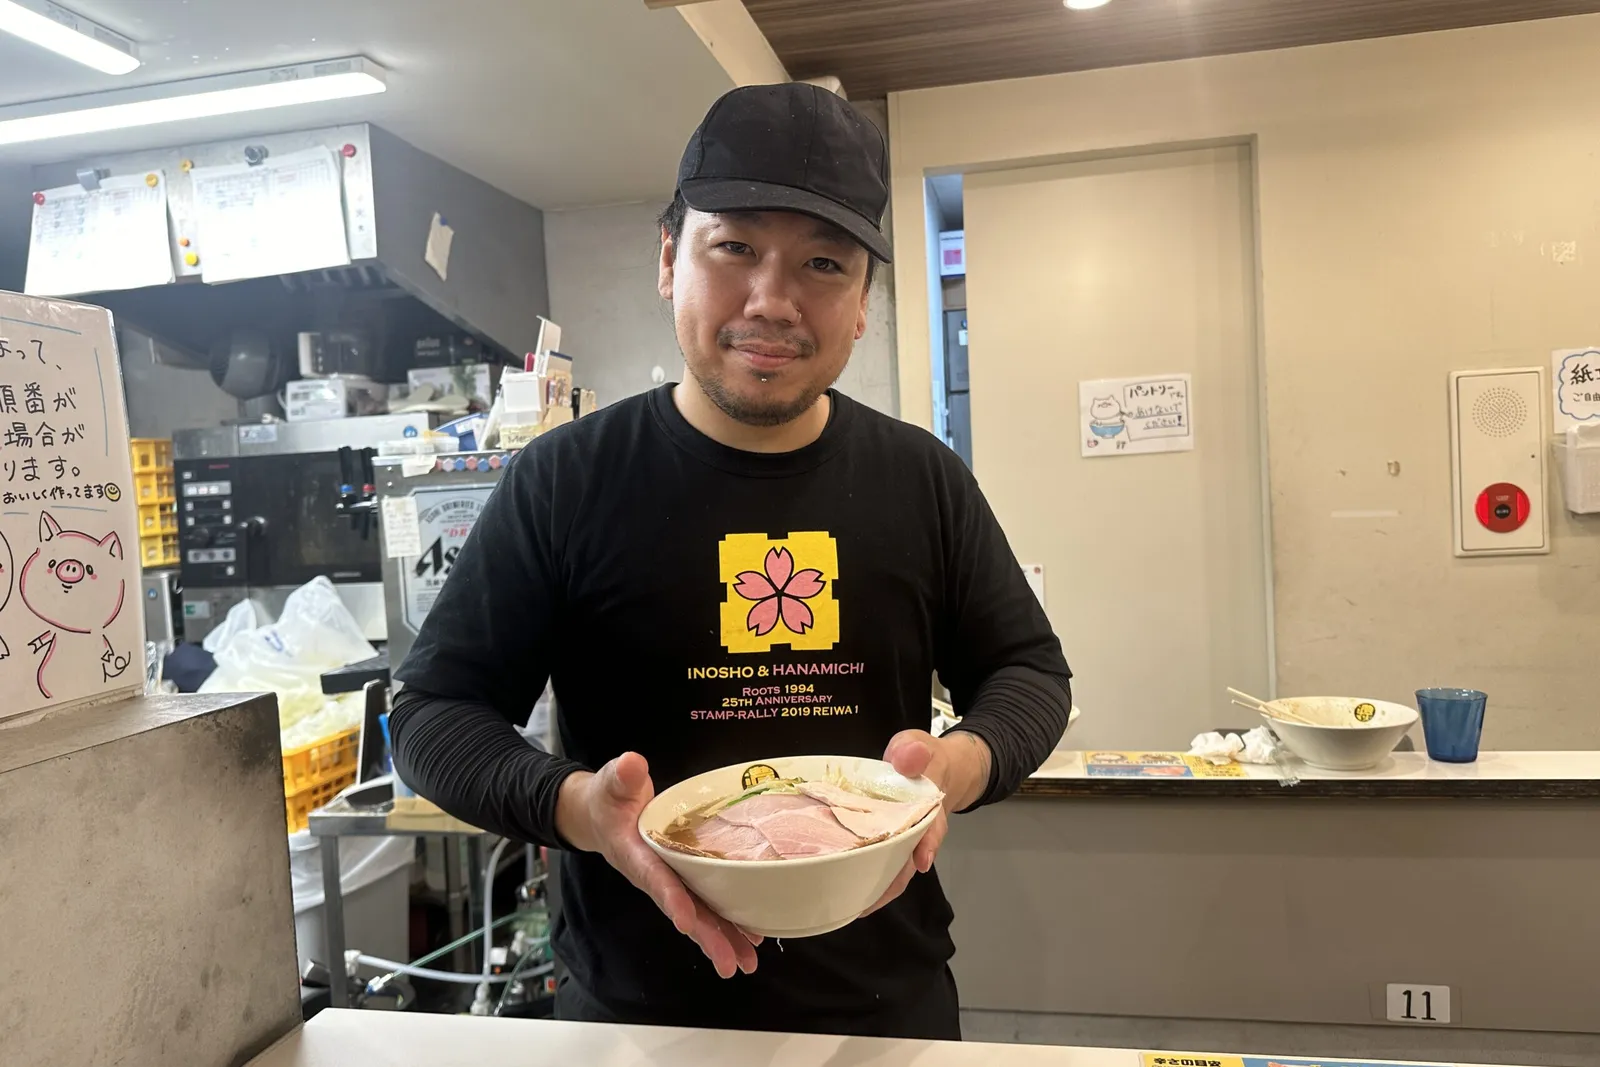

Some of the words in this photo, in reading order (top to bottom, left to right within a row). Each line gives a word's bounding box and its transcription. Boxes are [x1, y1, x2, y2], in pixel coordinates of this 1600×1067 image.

[4, 421, 85, 448] 場合が
[4, 456, 81, 482] ります。
[3, 484, 104, 504] おいしく作ってます
[688, 666, 754, 680] INOSHO
[757, 665, 769, 677] &
[772, 662, 865, 676] HANAMICHI
[742, 686, 781, 697] ROOTS
[784, 684, 815, 694] 1994
[722, 697, 752, 708] 25TH
[755, 695, 833, 706] ANNIVERSARY
[690, 708, 779, 720] STAMP-RALLY
[781, 706, 811, 717] 2019
[813, 705, 852, 716] REIWA
[854, 705, 859, 714] 1
[1402, 989, 1437, 1021] 11
